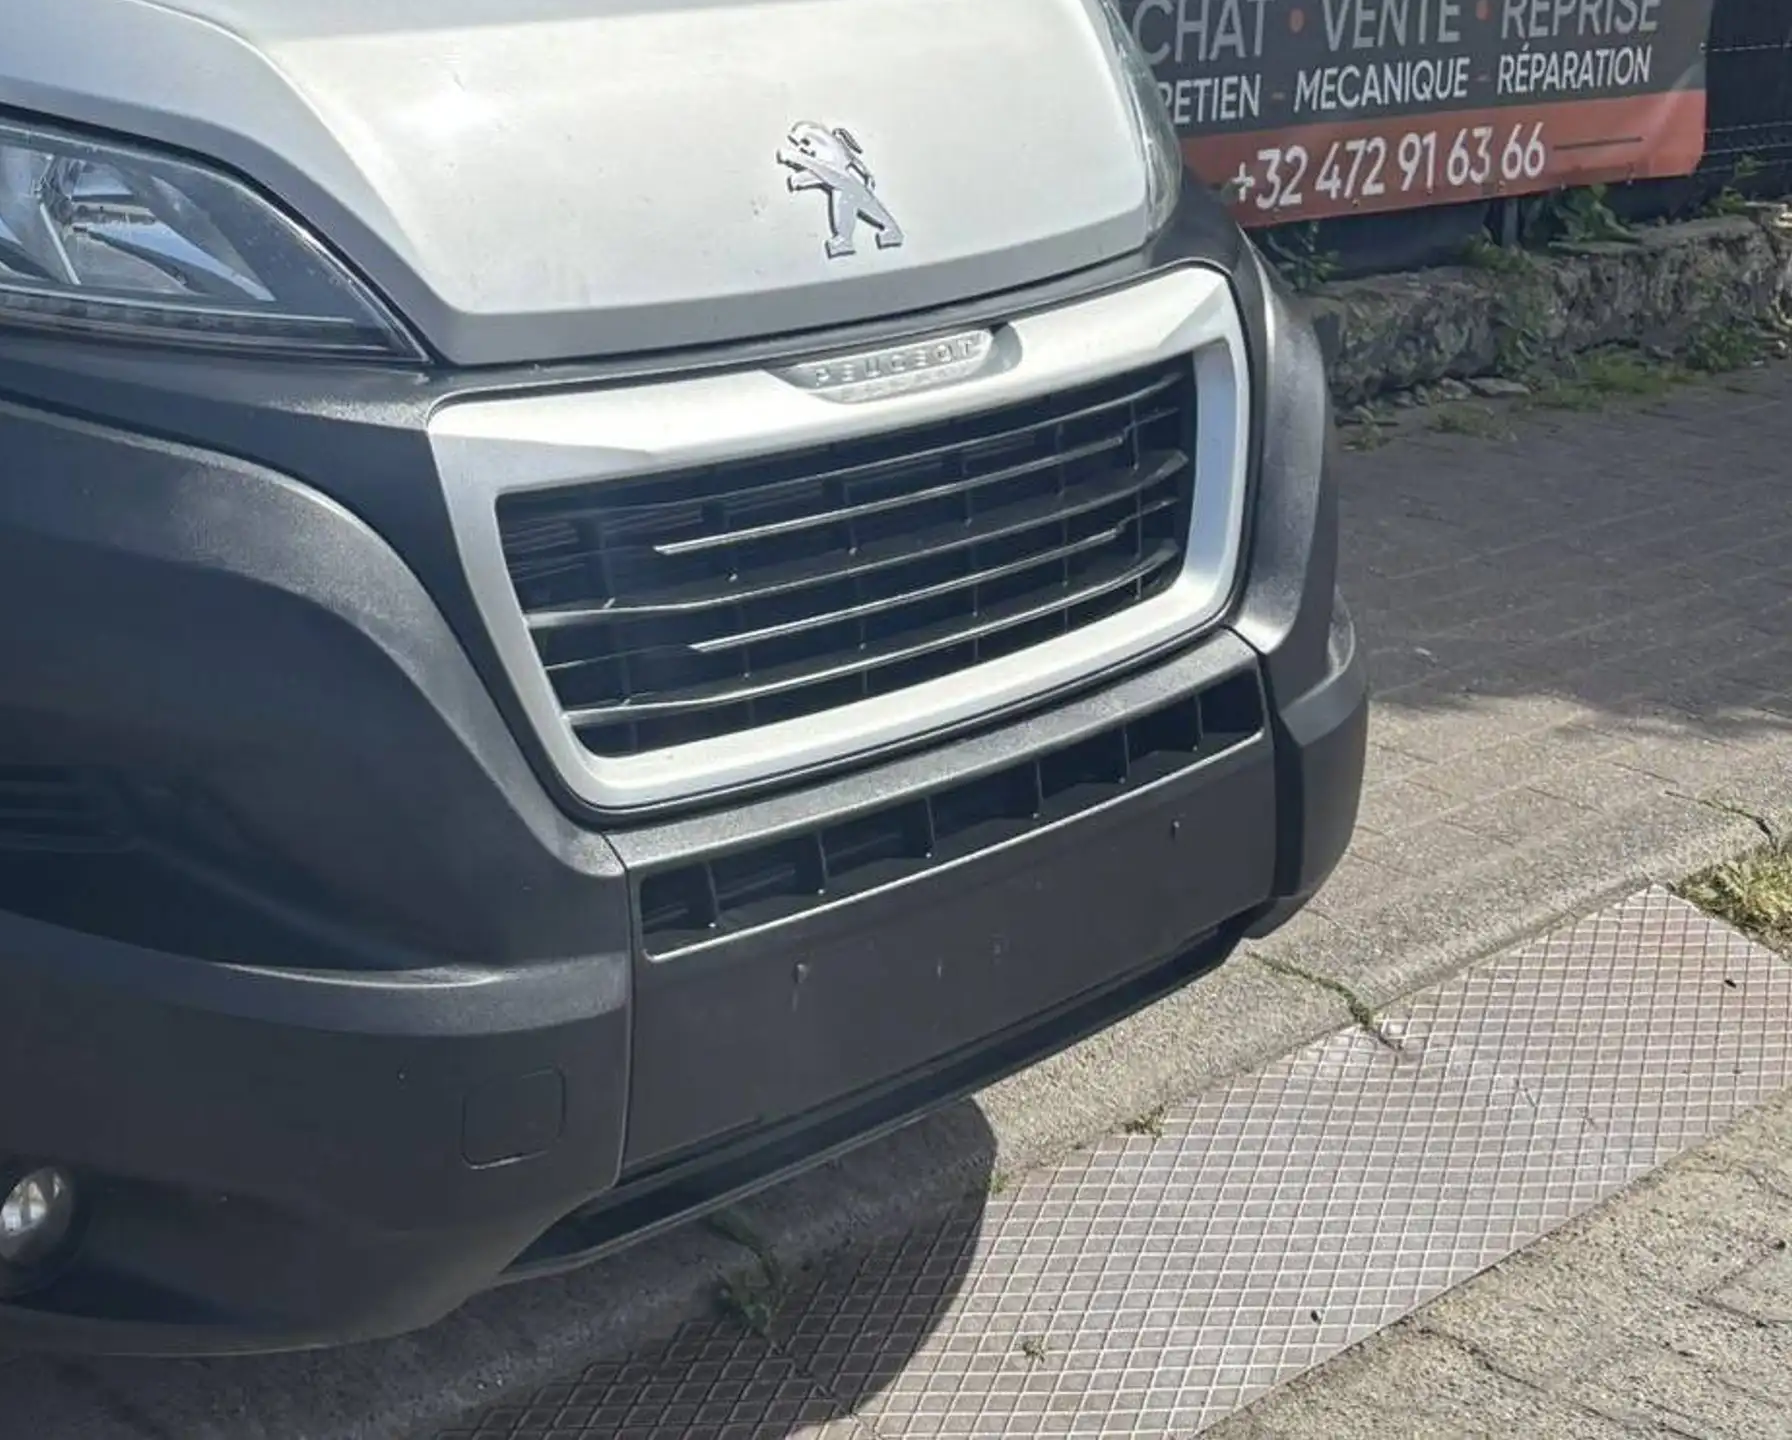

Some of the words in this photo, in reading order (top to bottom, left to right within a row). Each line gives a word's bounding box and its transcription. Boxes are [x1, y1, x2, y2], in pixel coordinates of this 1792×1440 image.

[1294, 56, 1470, 114] MECANIQUE
[1497, 43, 1653, 96] RÉPARATION
[1232, 144, 1308, 209] +32
[1315, 136, 1387, 200] 472
[1396, 130, 1436, 192] 91
[1445, 125, 1493, 186] 63
[1501, 121, 1546, 180] 66
